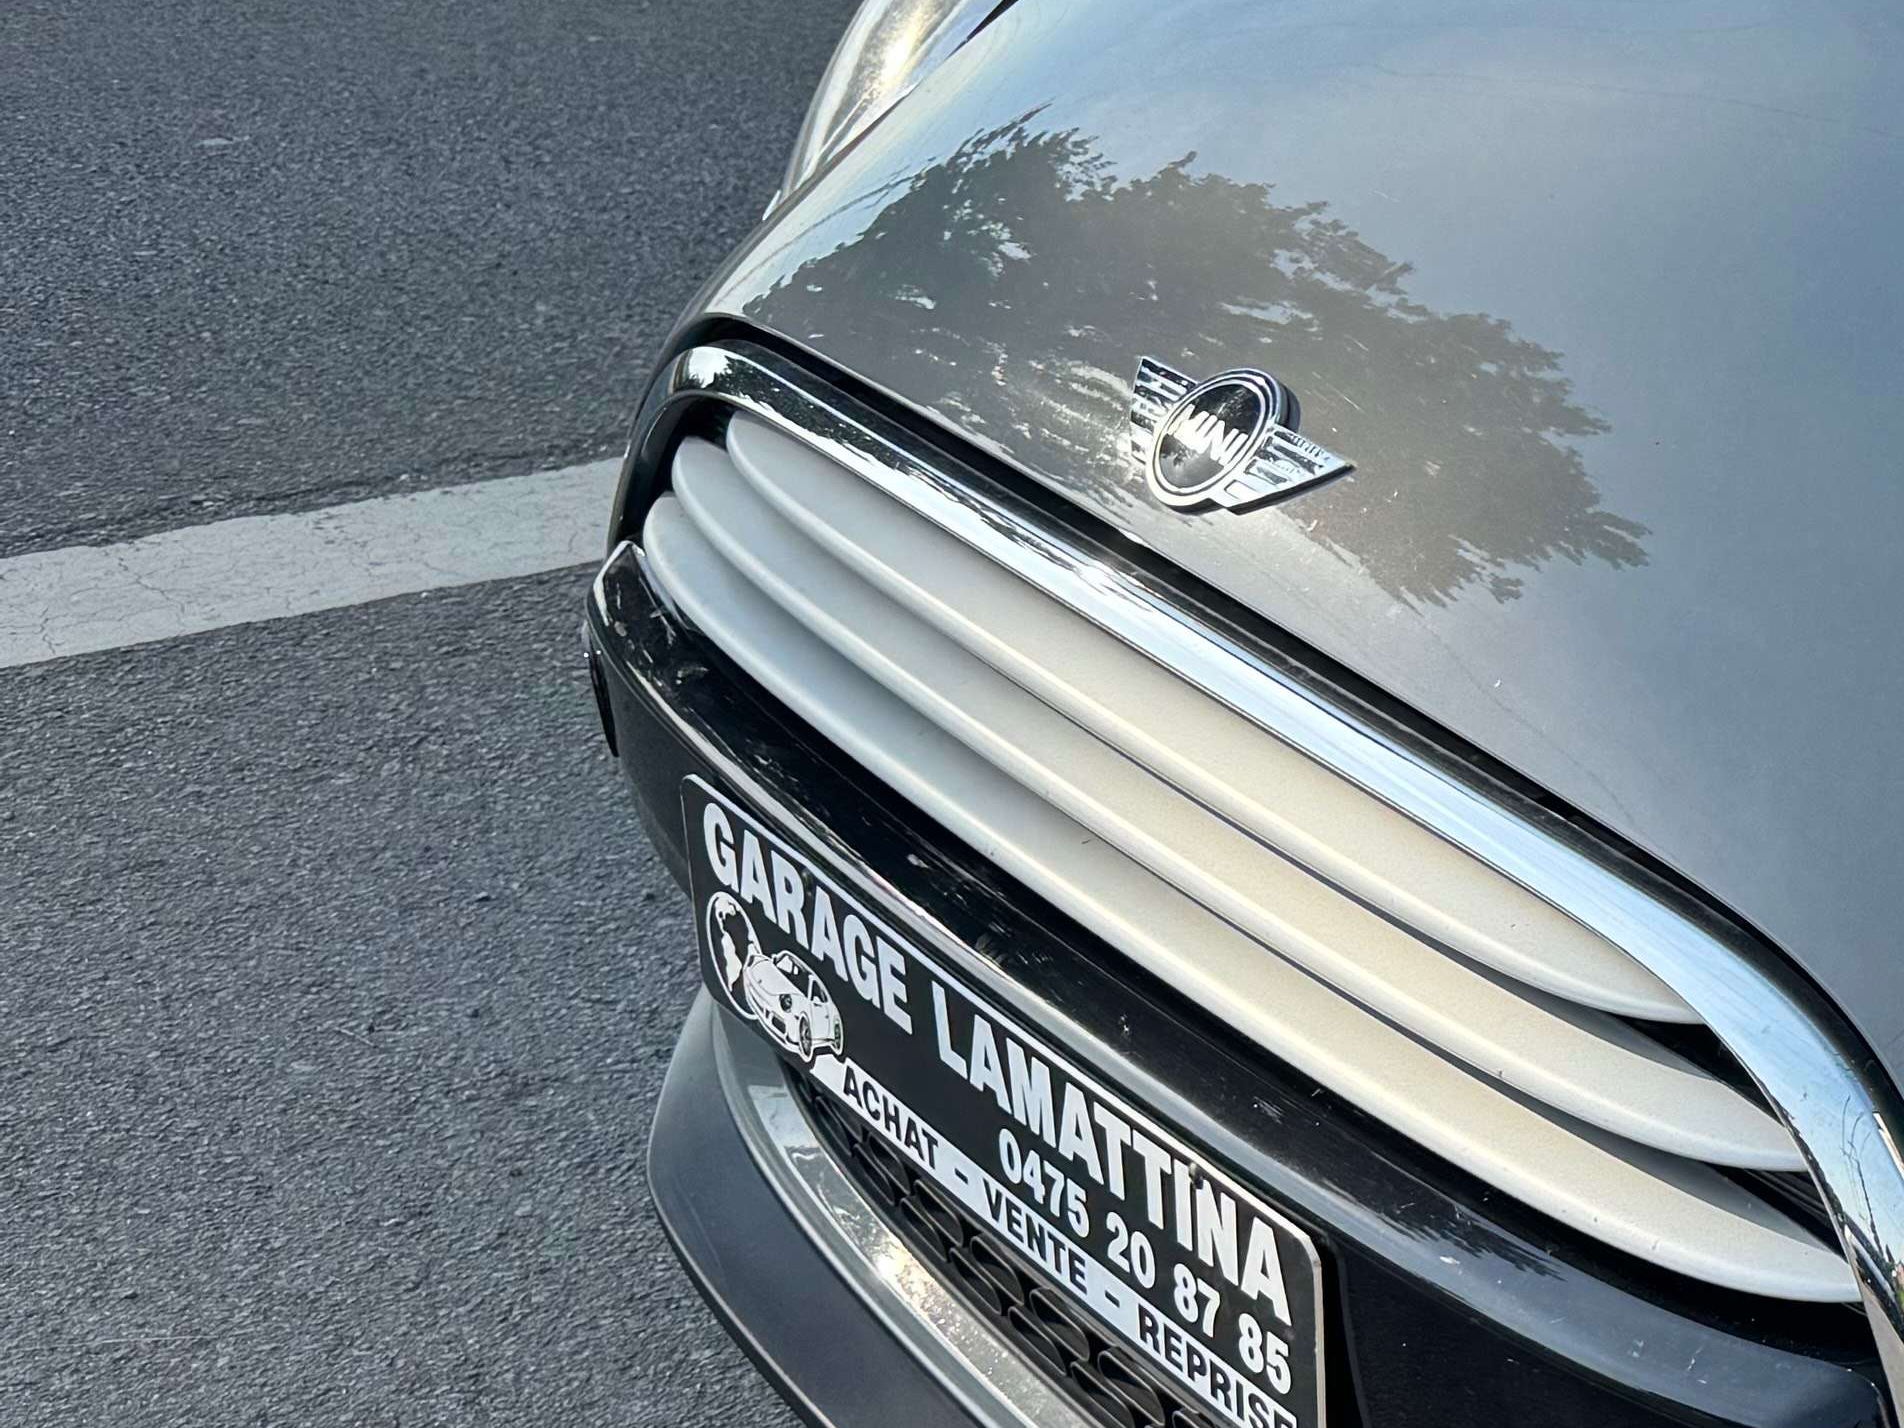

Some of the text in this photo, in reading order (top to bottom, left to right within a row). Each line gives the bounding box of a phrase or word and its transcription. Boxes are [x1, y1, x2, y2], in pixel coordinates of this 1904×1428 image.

[703, 802, 1292, 1327] GARAGE LAMATTINA
[843, 1064, 939, 1170] ACHAT
[982, 1177, 1088, 1296] VENTE
[999, 1128, 1292, 1395] 0475 20 87 85
